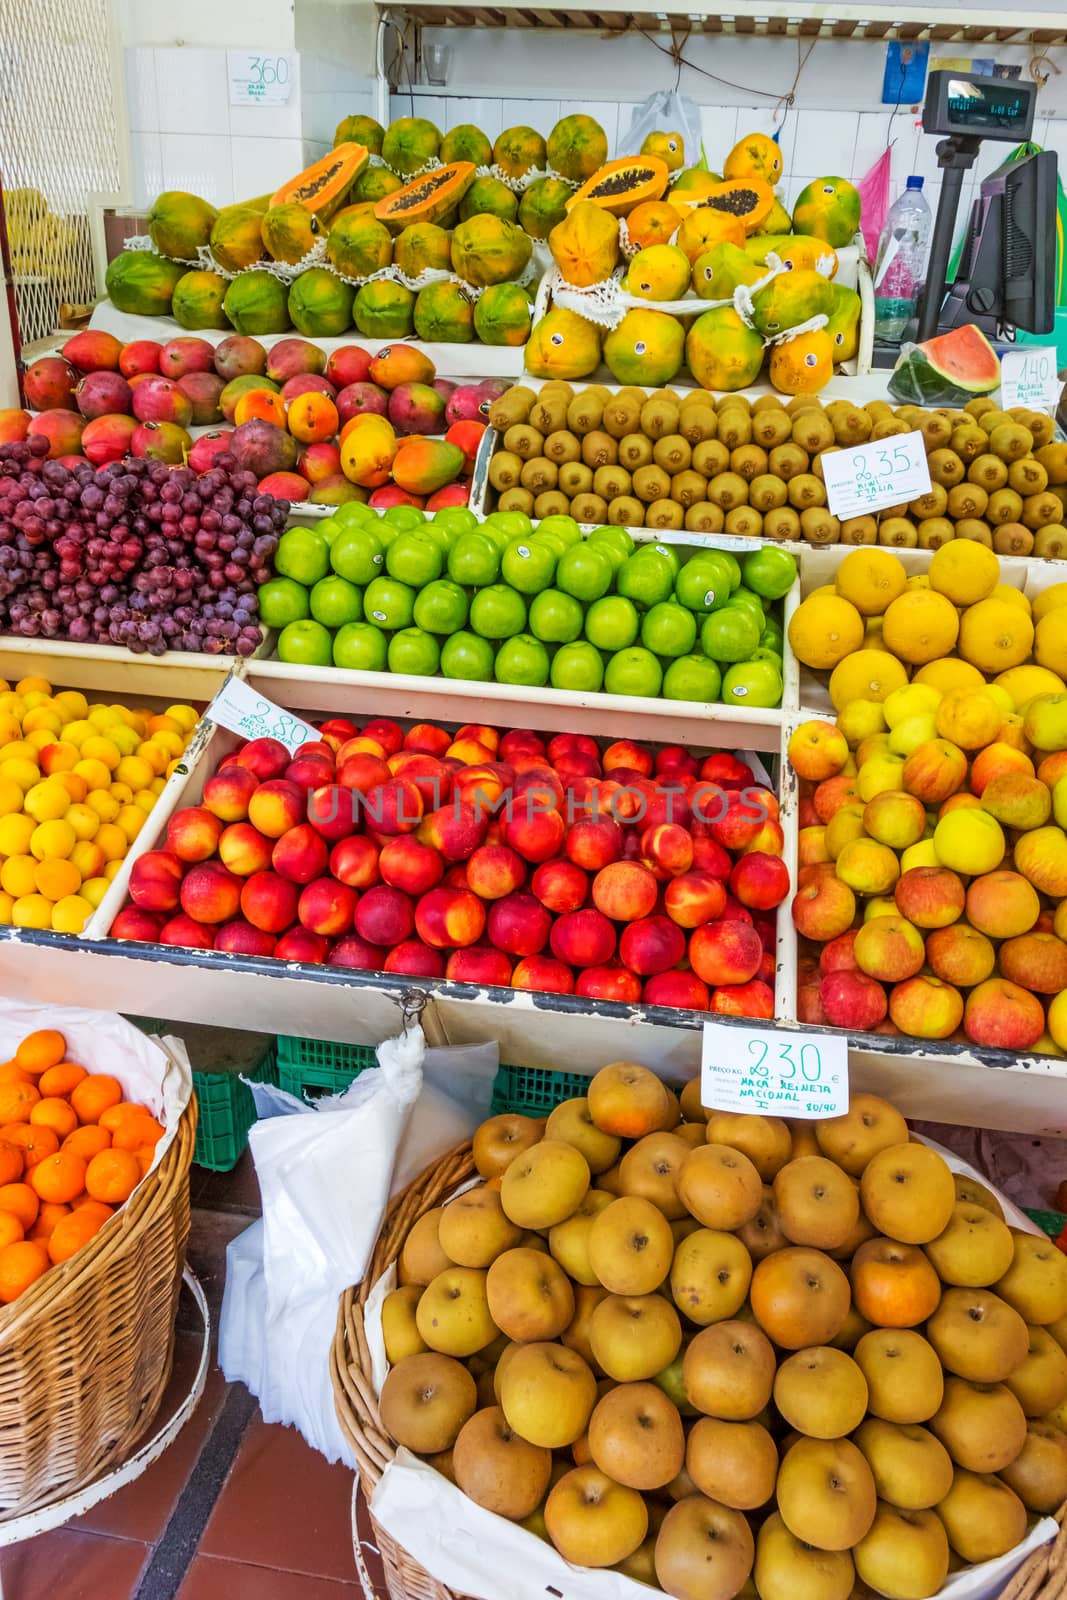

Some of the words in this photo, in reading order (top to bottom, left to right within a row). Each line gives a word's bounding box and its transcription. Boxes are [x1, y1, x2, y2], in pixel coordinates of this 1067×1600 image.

[248, 57, 288, 84] 360
[855, 483, 894, 497] ITALIA
[739, 1089, 800, 1102] NACIONAL
